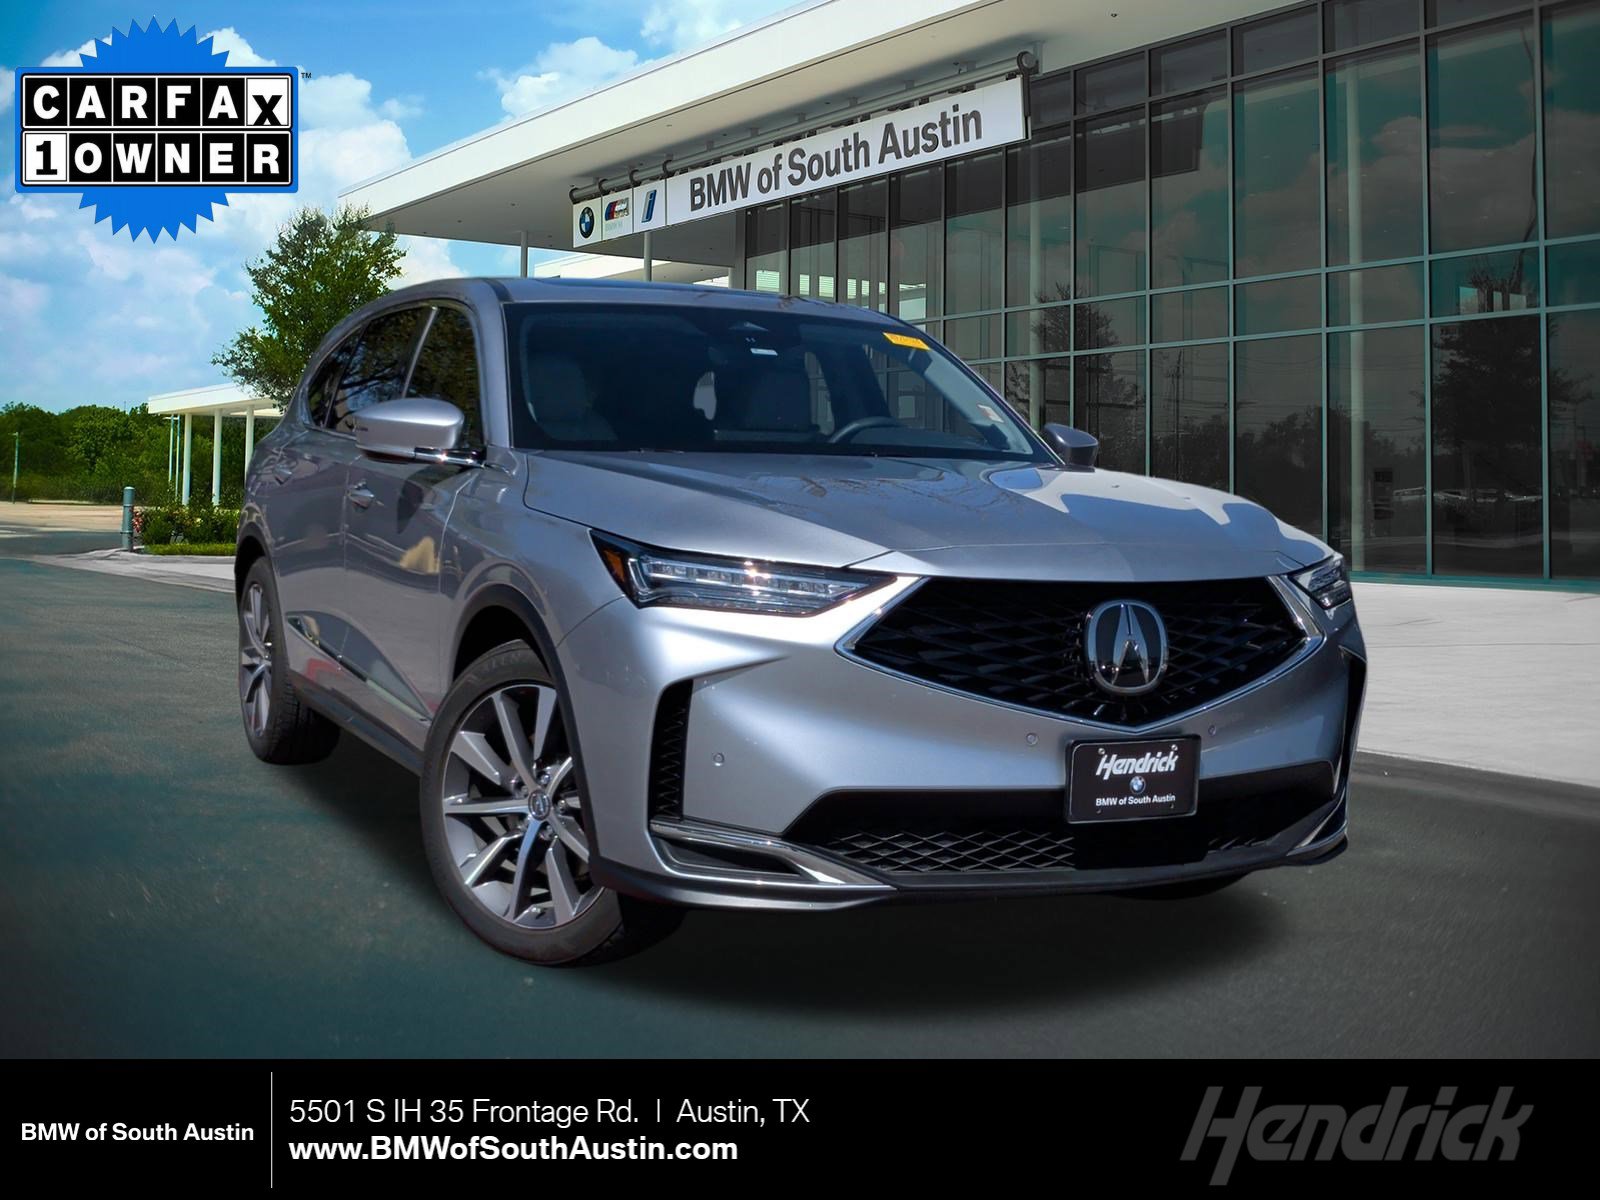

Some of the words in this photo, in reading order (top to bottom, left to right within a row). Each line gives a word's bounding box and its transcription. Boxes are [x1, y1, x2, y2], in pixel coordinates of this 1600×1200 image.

[690, 163, 751, 212] BMW
[757, 153, 783, 194] of
[788, 131, 870, 187] South
[878, 103, 982, 165] Austin
[1095, 751, 1179, 780] Hendrick
[1095, 797, 1118, 807] BMW
[1118, 797, 1127, 806] of
[1128, 795, 1151, 805] South
[1152, 793, 1176, 803] Austin
